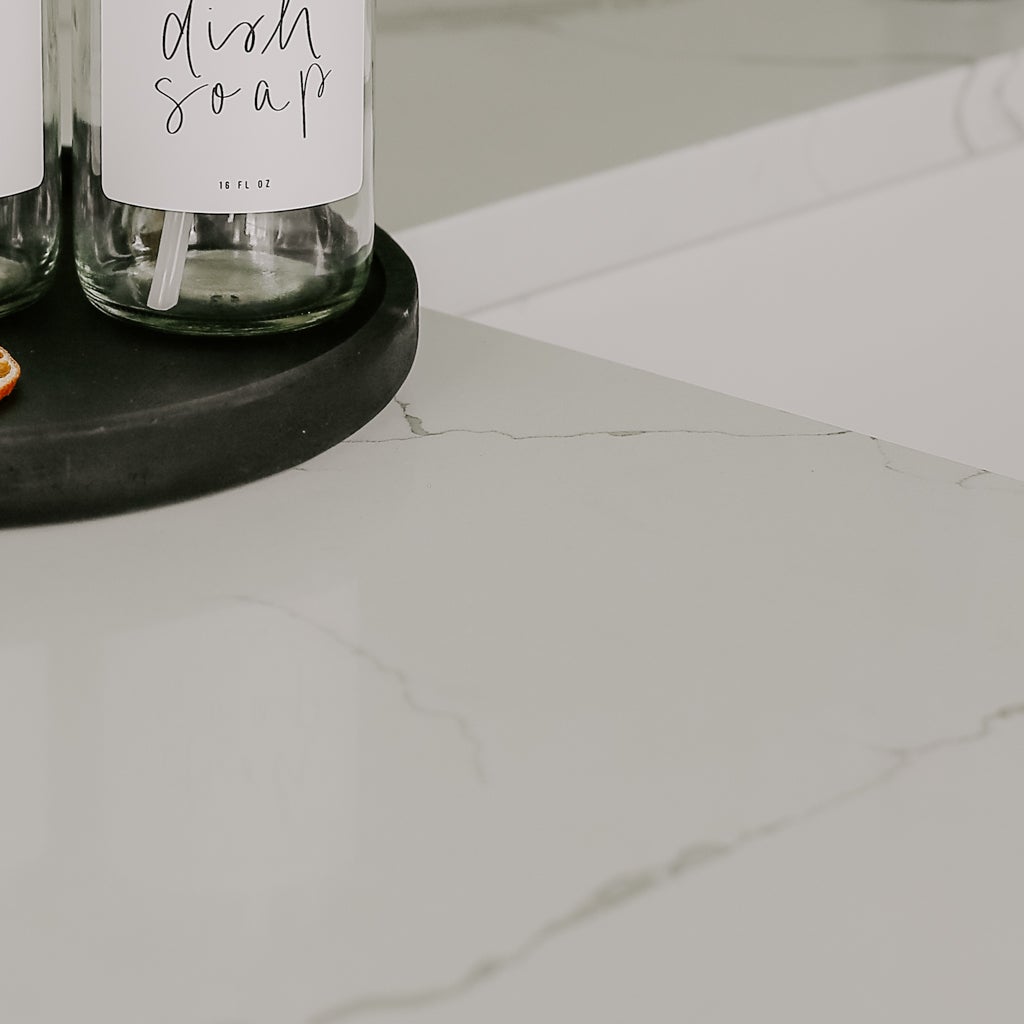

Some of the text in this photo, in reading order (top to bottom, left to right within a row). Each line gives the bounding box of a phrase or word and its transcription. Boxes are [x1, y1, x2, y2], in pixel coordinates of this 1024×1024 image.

[154, 62, 332, 139] soap
[219, 179, 270, 190] 16 FL OZ
